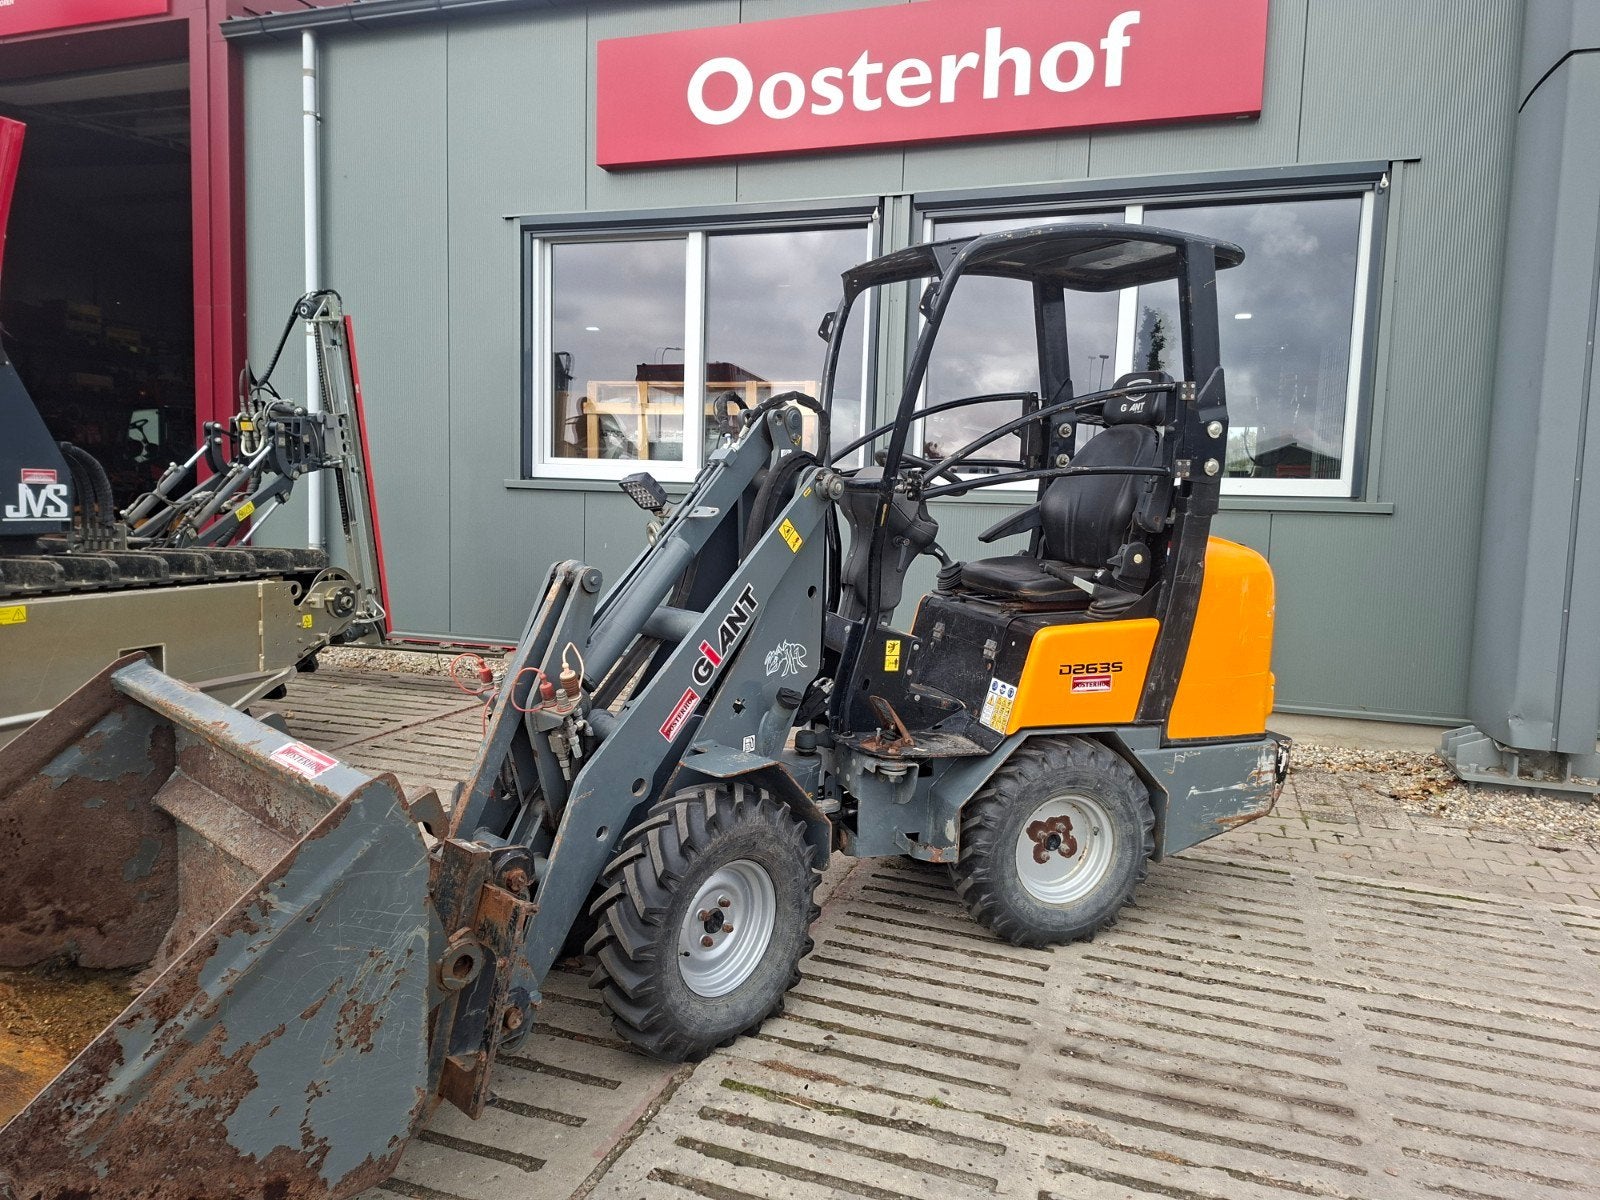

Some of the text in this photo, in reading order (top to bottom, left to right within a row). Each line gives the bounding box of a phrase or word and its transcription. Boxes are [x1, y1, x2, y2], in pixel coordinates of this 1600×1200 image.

[687, 10, 1140, 125] Oosterhof
[1120, 401, 1146, 412] GANT
[1059, 661, 1123, 675] D263S
